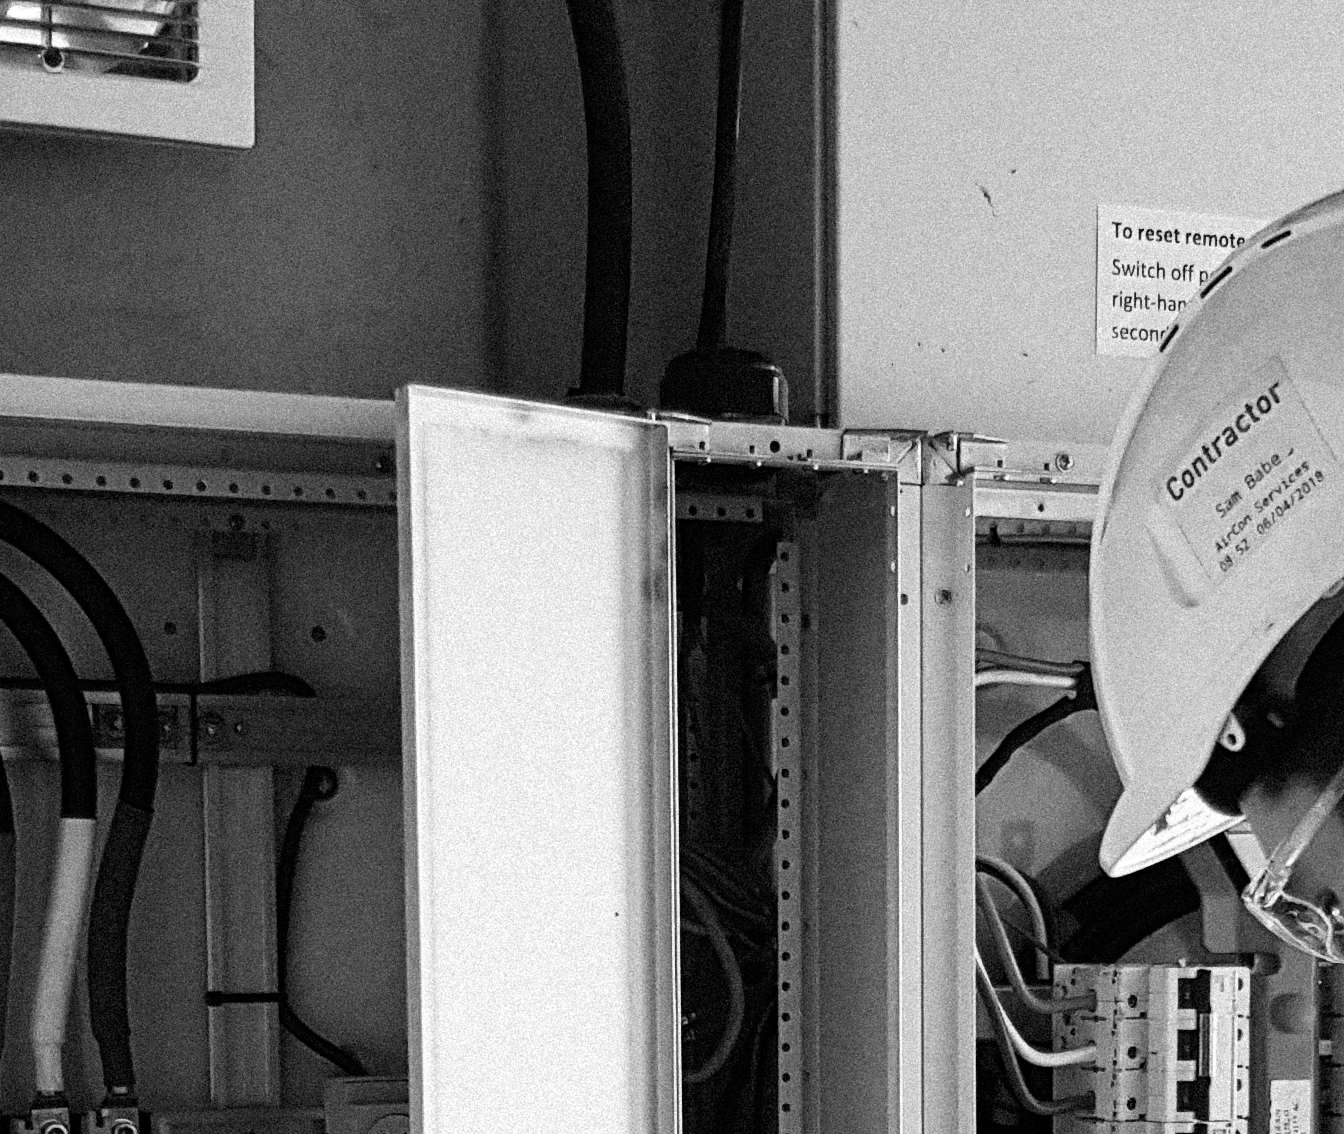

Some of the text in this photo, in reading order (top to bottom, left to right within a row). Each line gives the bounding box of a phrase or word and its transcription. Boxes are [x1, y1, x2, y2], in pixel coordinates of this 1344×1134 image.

[1112, 221, 1246, 249] To reset remote
[1112, 258, 1166, 280] Switch
[1171, 264, 1195, 282] off
[1166, 382, 1281, 501] Contractor
[1215, 454, 1282, 519] Sam Babe
[1254, 461, 1310, 514] Services
